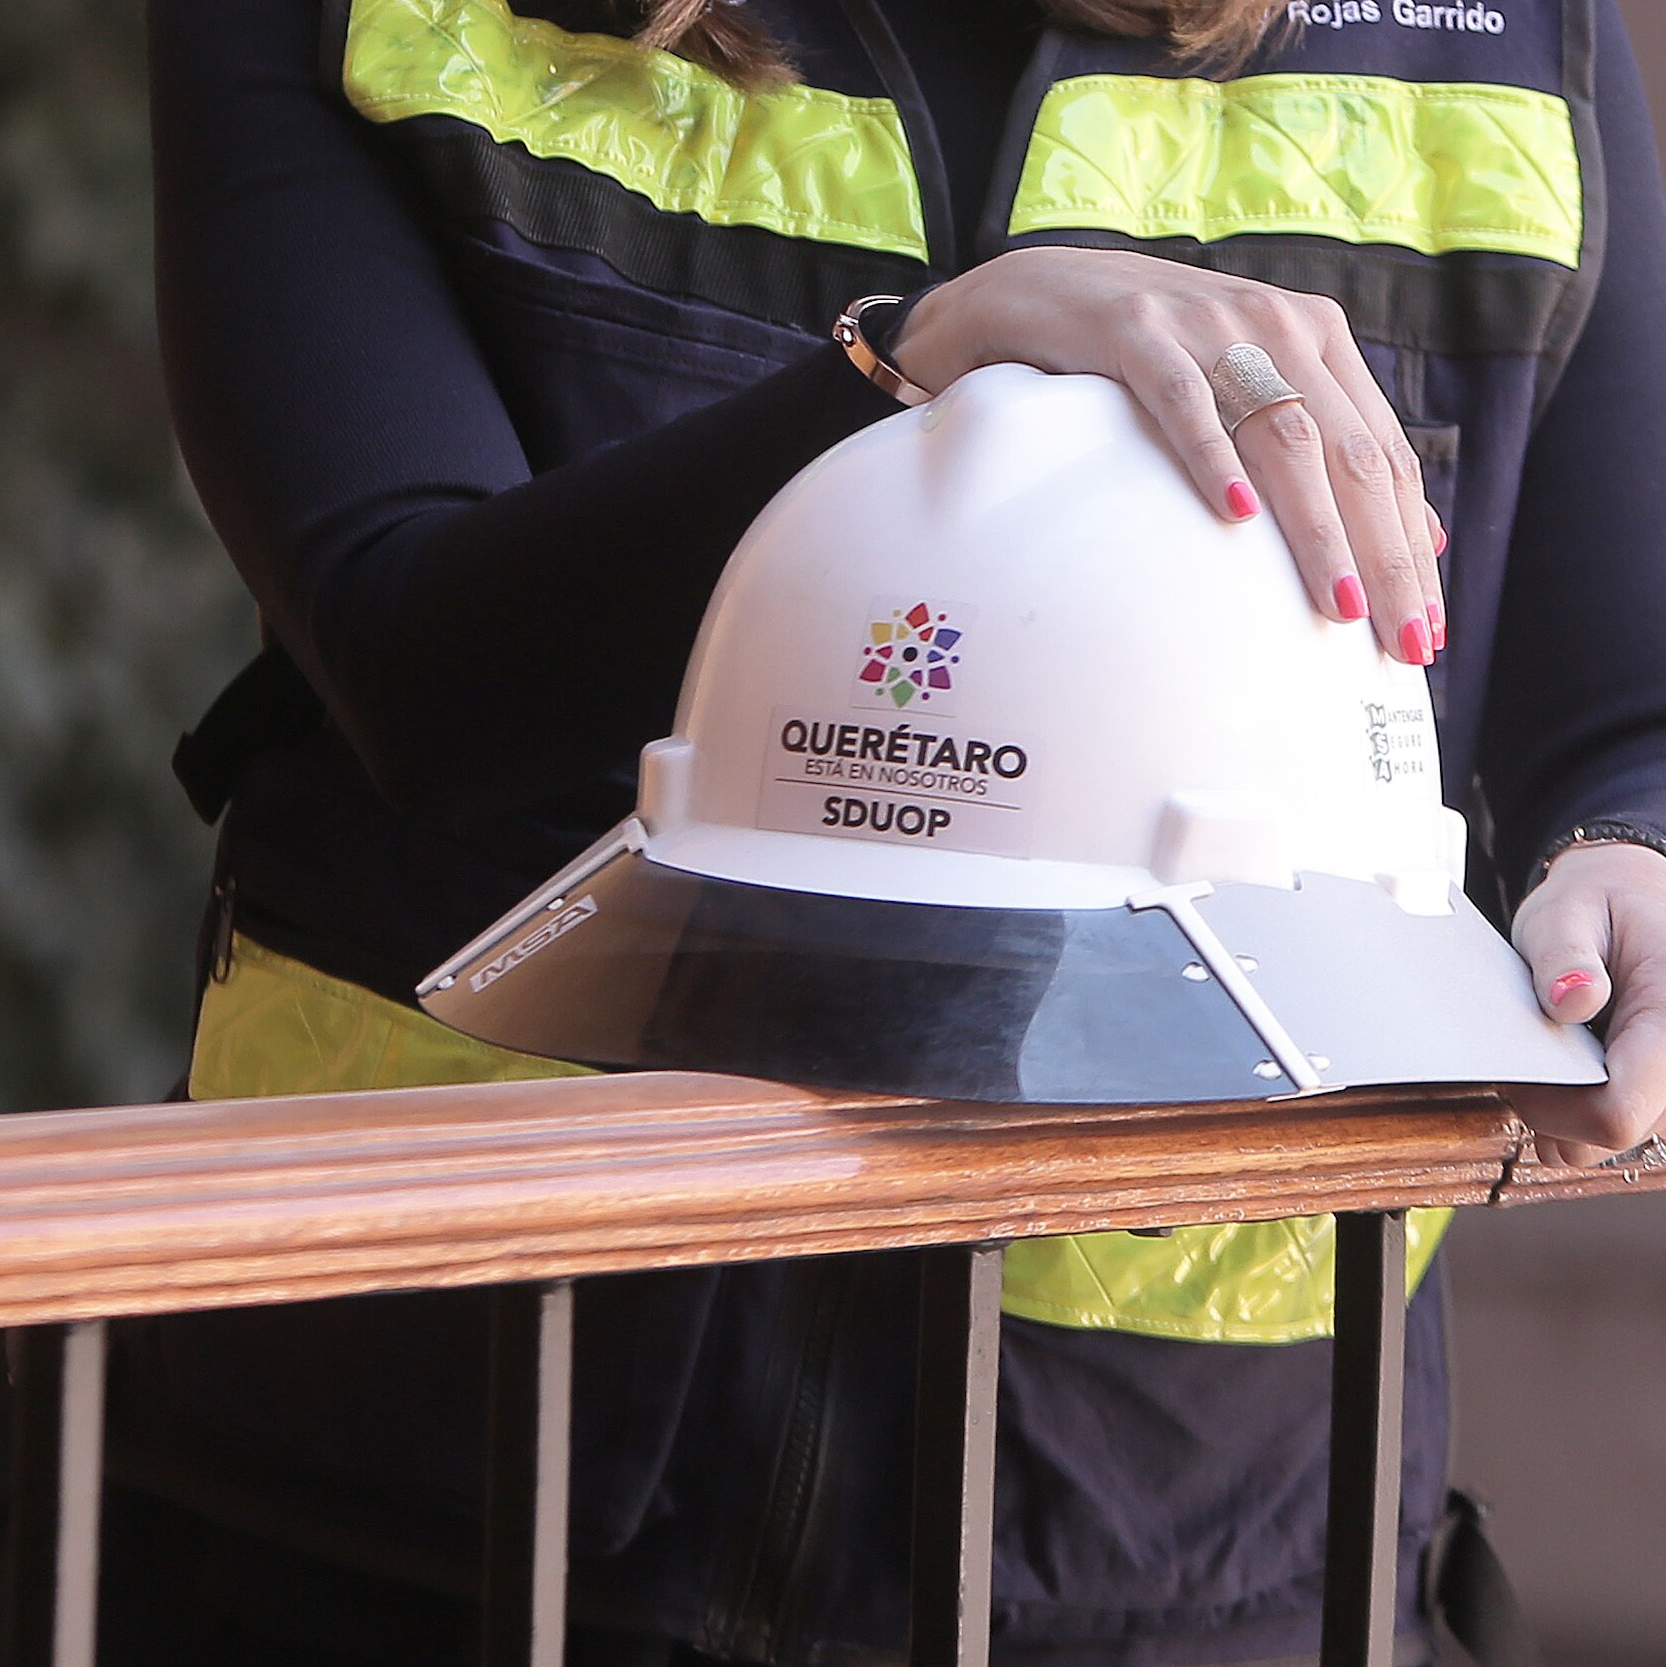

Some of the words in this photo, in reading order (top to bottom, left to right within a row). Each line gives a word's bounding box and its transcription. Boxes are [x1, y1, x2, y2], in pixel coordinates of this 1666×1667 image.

[780, 718, 1028, 780] QUERÉTARO
[1376, 758, 1425, 782] AHORA
[805, 757, 844, 778] ESTÁ
[850, 764, 873, 782] EN
[880, 767, 989, 797] NOSOTROS
[821, 795, 952, 838] SDUOP
[477, 902, 592, 986] MSA
